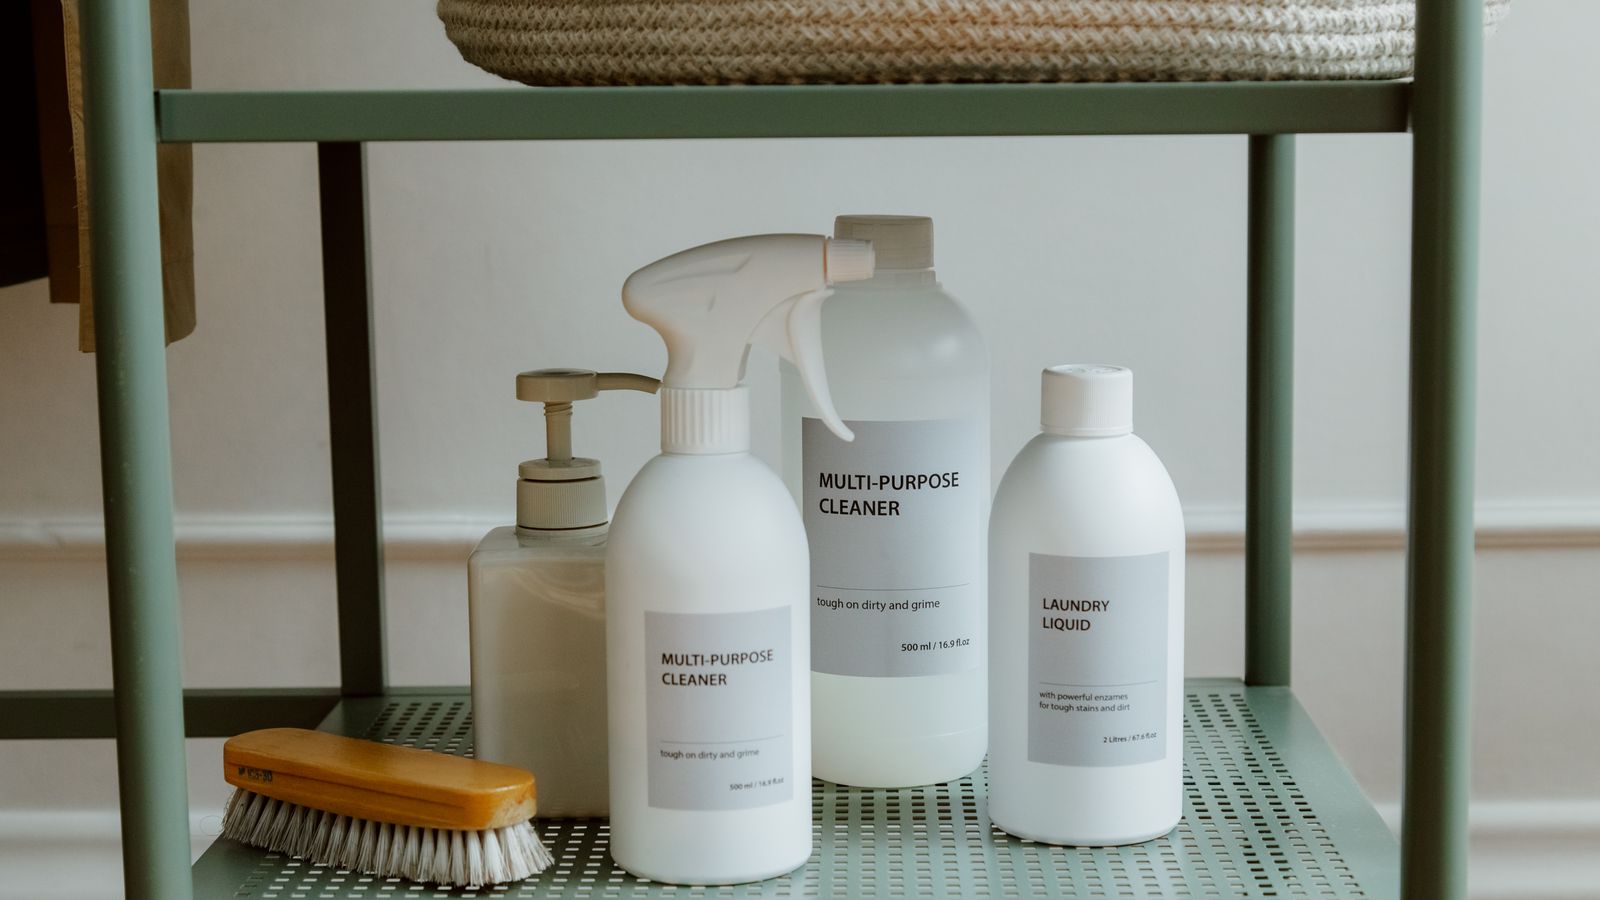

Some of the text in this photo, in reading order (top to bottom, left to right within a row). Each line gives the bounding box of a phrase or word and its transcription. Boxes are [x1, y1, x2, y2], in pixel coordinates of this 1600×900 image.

[819, 472, 959, 490] MULTI-PURPOSE
[819, 498, 900, 516] CLEANER
[817, 597, 940, 613] tough on dirty and grime
[1043, 598, 1110, 612] LAUNDRY
[1043, 617, 1091, 631] LIQUID
[901, 638, 970, 652] 500 ml / 16.9 fl.oz
[661, 649, 774, 666] MULTI-PURPOSE
[661, 672, 727, 686] CLEANER
[1039, 691, 1056, 700] with
[1057, 693, 1093, 702] powerful
[1039, 701, 1130, 713] for tough stains and dirt
[660, 750, 684, 760] tough
[698, 750, 718, 760] dirty
[720, 750, 735, 759] and
[737, 749, 760, 759] grime
[729, 783, 743, 791] 500
